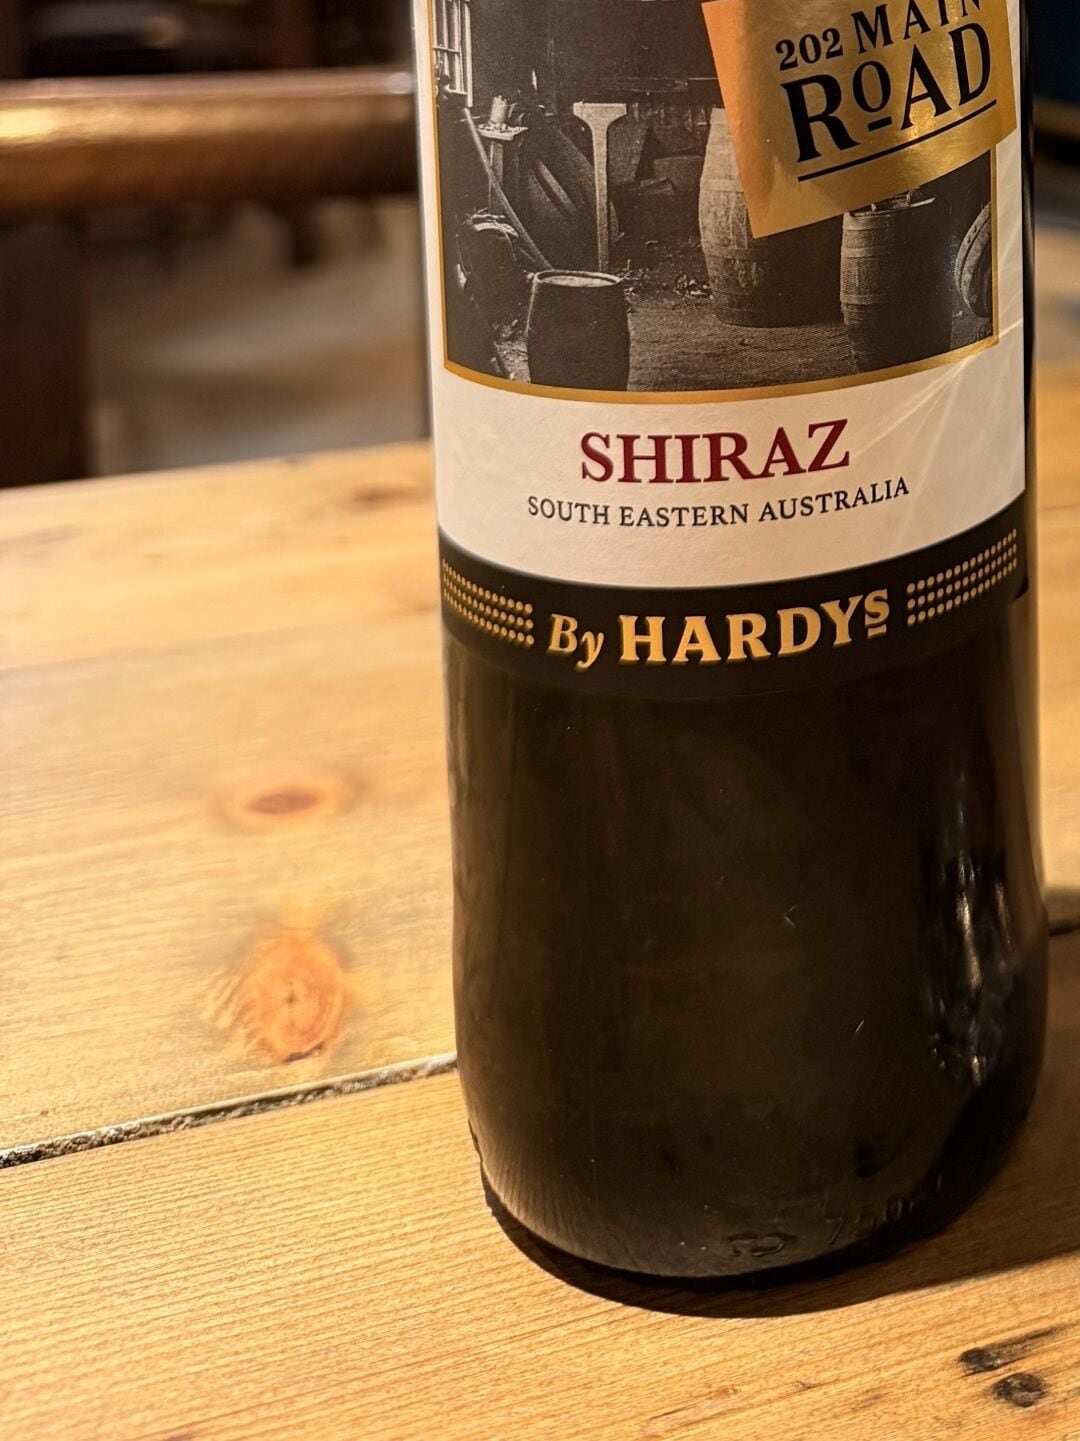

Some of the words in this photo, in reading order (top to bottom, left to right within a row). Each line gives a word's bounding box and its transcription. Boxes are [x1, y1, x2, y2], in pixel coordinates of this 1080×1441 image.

[775, 28, 844, 71] 202
[781, 23, 991, 163] ROAD
[580, 418, 850, 483] SHIRAZ
[527, 496, 610, 526] SOUTH
[619, 504, 749, 527] EASTERN
[758, 476, 910, 522] AUSTRALIA
[550, 613, 604, 670] By
